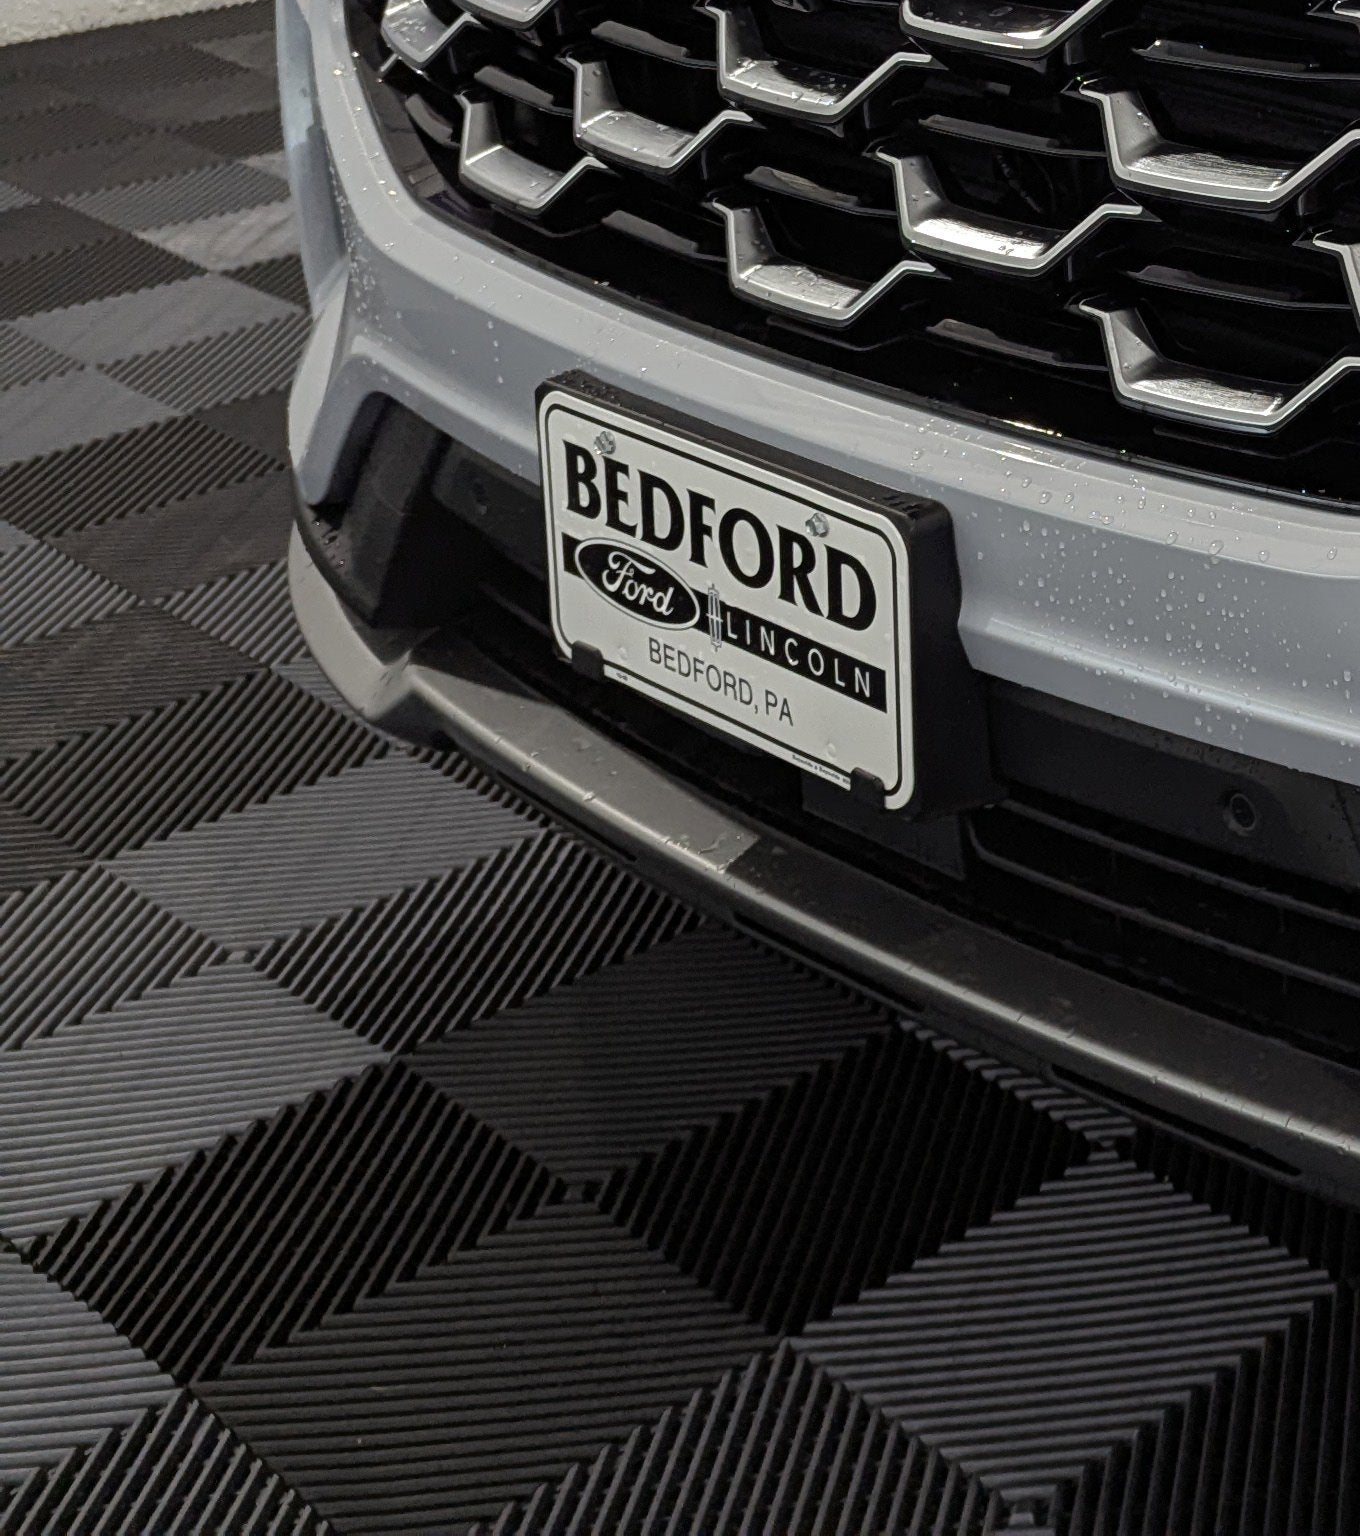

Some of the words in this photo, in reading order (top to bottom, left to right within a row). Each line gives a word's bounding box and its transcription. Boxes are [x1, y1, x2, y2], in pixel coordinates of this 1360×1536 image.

[562, 440, 877, 631] BEDFORD
[601, 551, 675, 617] Ford
[648, 636, 759, 714] BEDFORD,
[764, 690, 794, 727] PA
[726, 615, 872, 698] LINCOLN
